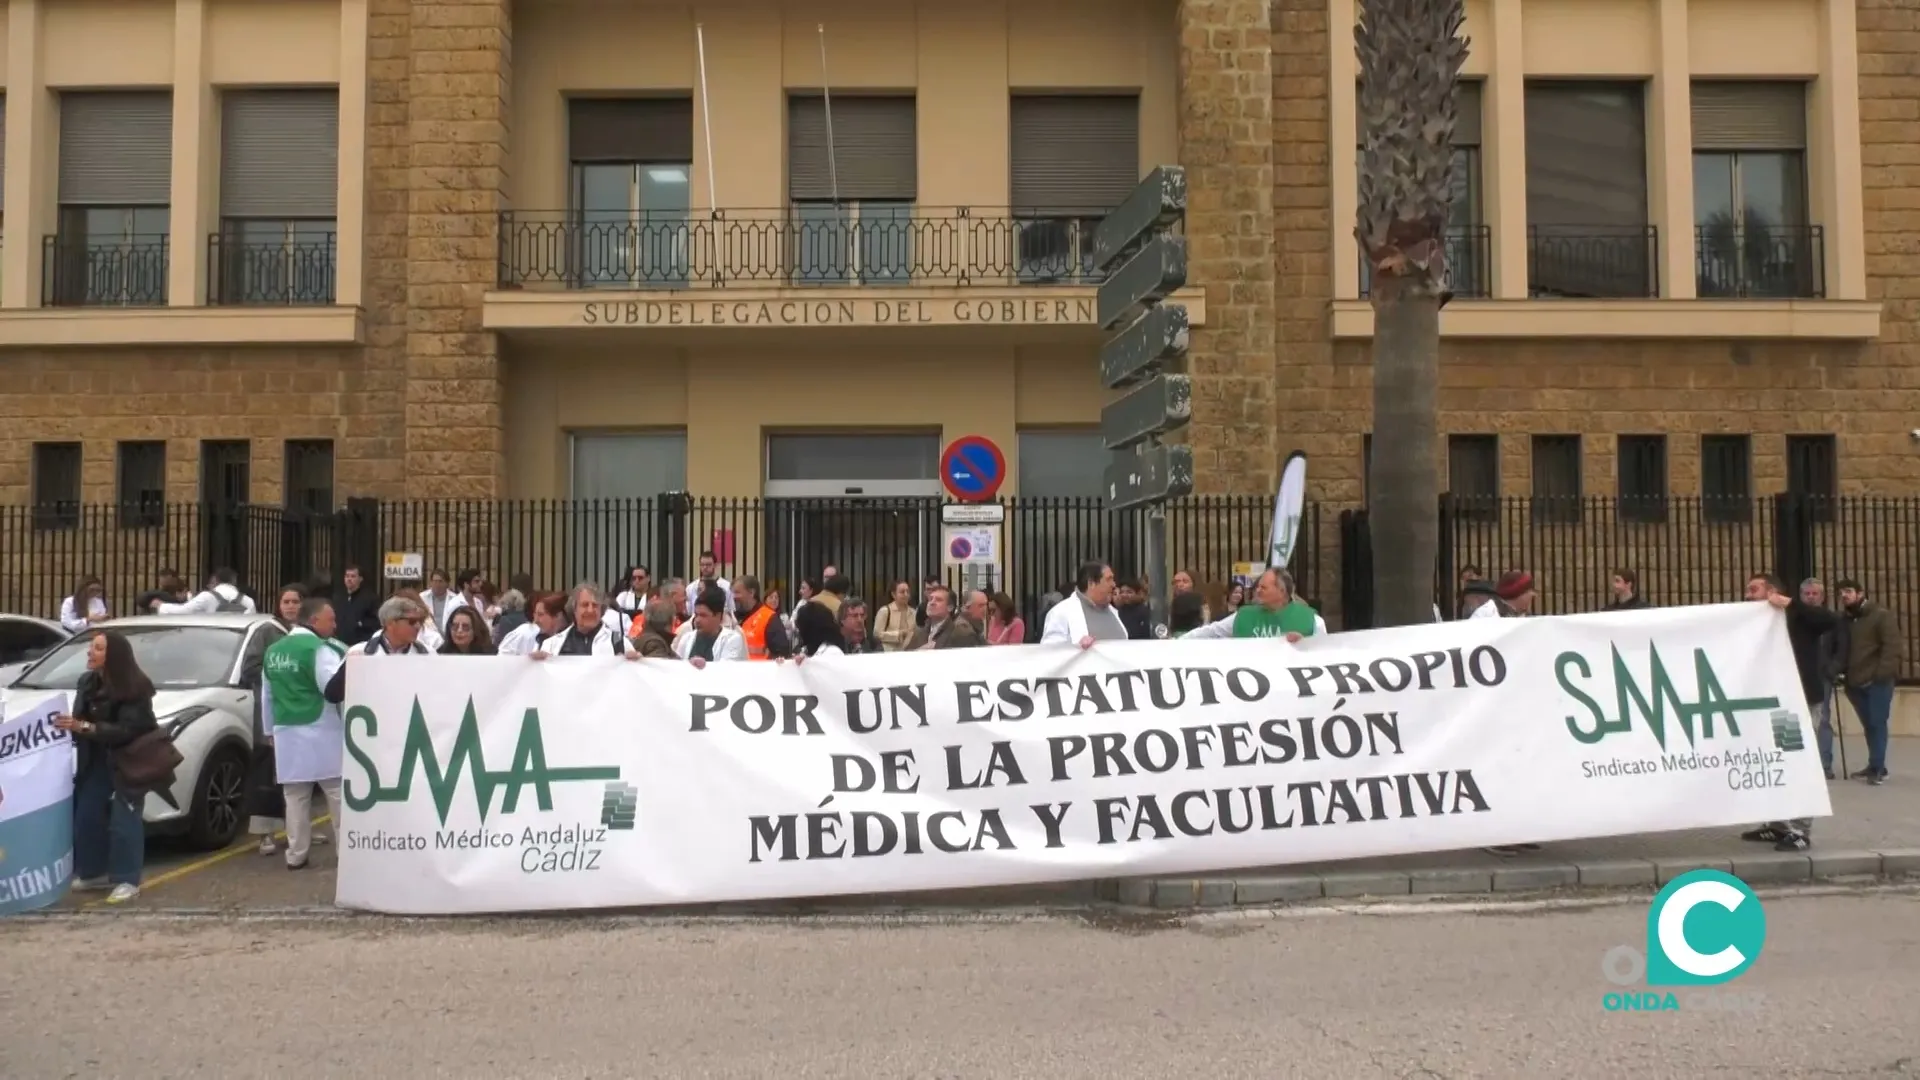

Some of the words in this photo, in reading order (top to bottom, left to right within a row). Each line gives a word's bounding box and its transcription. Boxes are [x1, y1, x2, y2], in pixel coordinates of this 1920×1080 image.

[583, 302, 855, 324] SUBDELEGACION
[874, 301, 932, 322] DEL
[953, 300, 1093, 321] GOBIERN
[386, 566, 420, 576] SALIDA
[688, 693, 825, 735] POR
[843, 683, 930, 734] UN
[954, 667, 1271, 724] ESTATUTO
[1288, 644, 1507, 698] PROPIO
[1554, 637, 1781, 753] SMA
[343, 692, 621, 829] SMA
[829, 748, 921, 794] DE
[943, 740, 1029, 791] LA
[1046, 697, 1405, 783] PROFESIÓN
[1581, 757, 1657, 779] Sindicato
[1660, 752, 1720, 773] Médico
[1723, 747, 1785, 768] Andaluz
[1727, 765, 1787, 791] Cádiz
[748, 794, 1018, 862] MÉDICA
[1029, 801, 1073, 848] Y
[1092, 769, 1492, 845] FACULTATIVA
[347, 830, 427, 851] Sindicato
[435, 829, 514, 850] Médico
[520, 822, 607, 846] Andaluz
[520, 844, 603, 874] Cádiz
